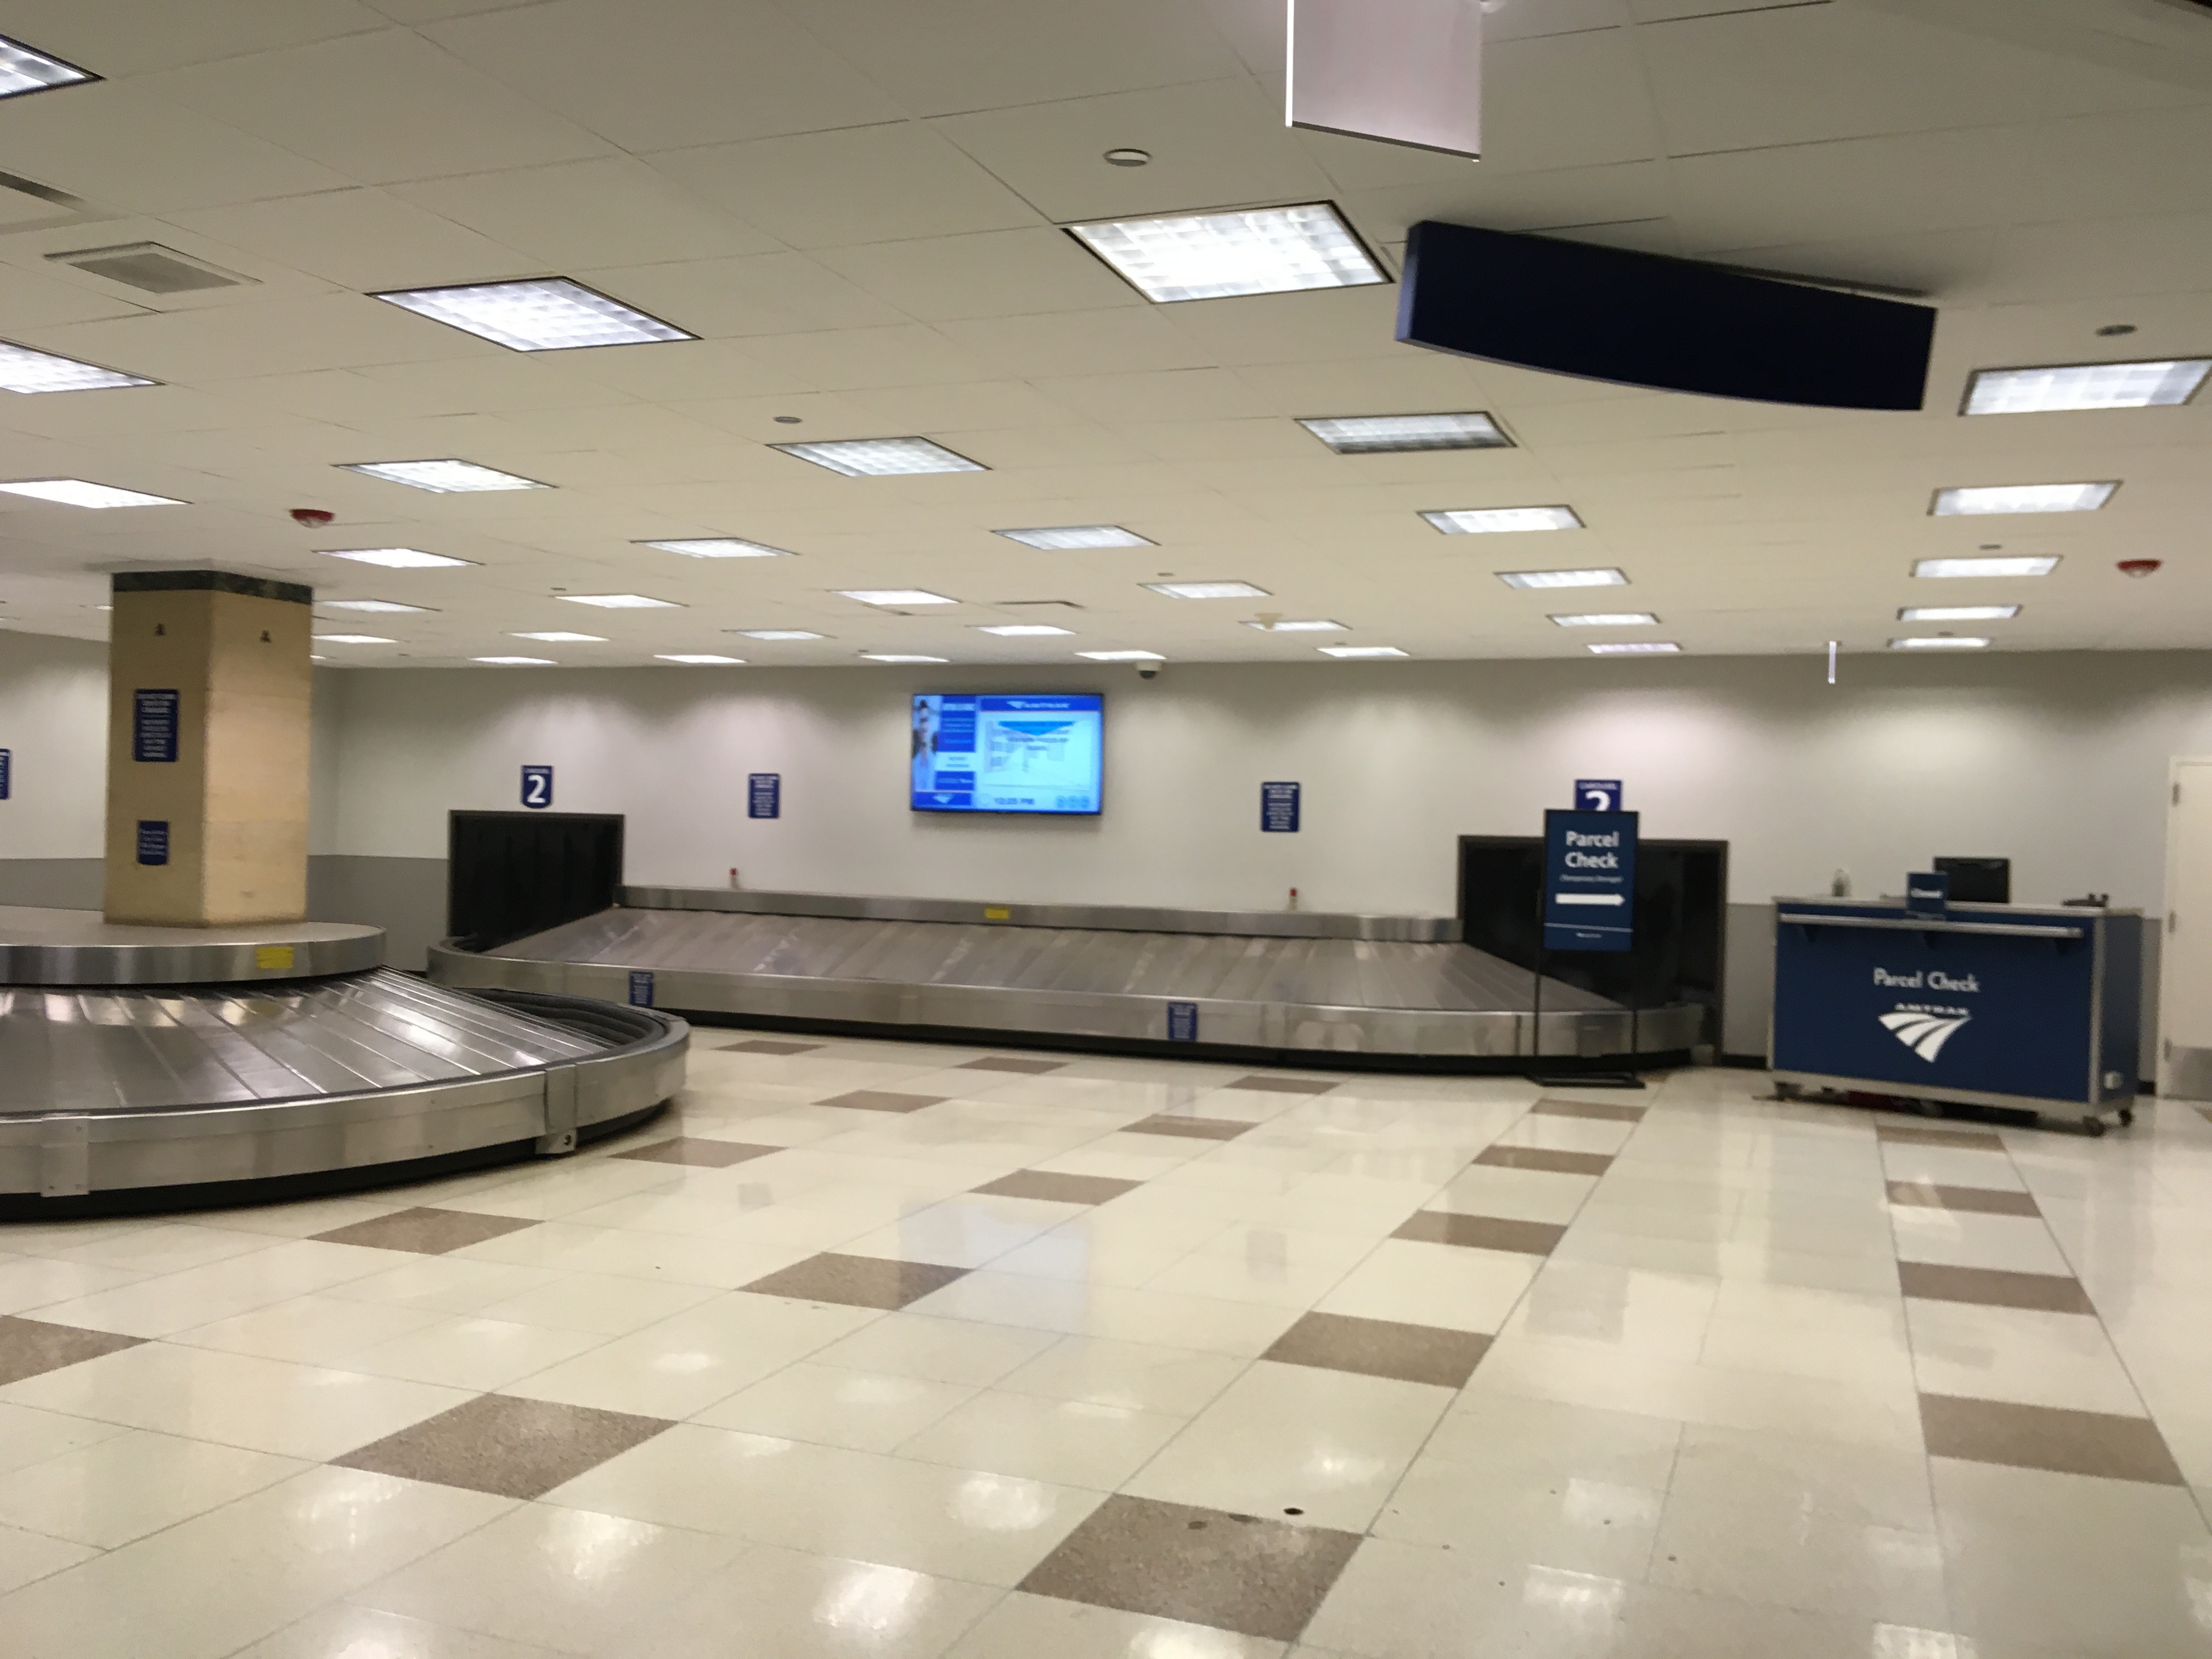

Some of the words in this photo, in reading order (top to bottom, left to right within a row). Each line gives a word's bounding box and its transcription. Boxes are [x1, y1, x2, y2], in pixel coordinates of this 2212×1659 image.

[527, 775, 546, 803] 2
[1565, 831, 1620, 848] Parcel
[1565, 851, 1618, 869] Check
[1873, 967, 1923, 989] Parcel
[1926, 970, 1980, 993] Check
